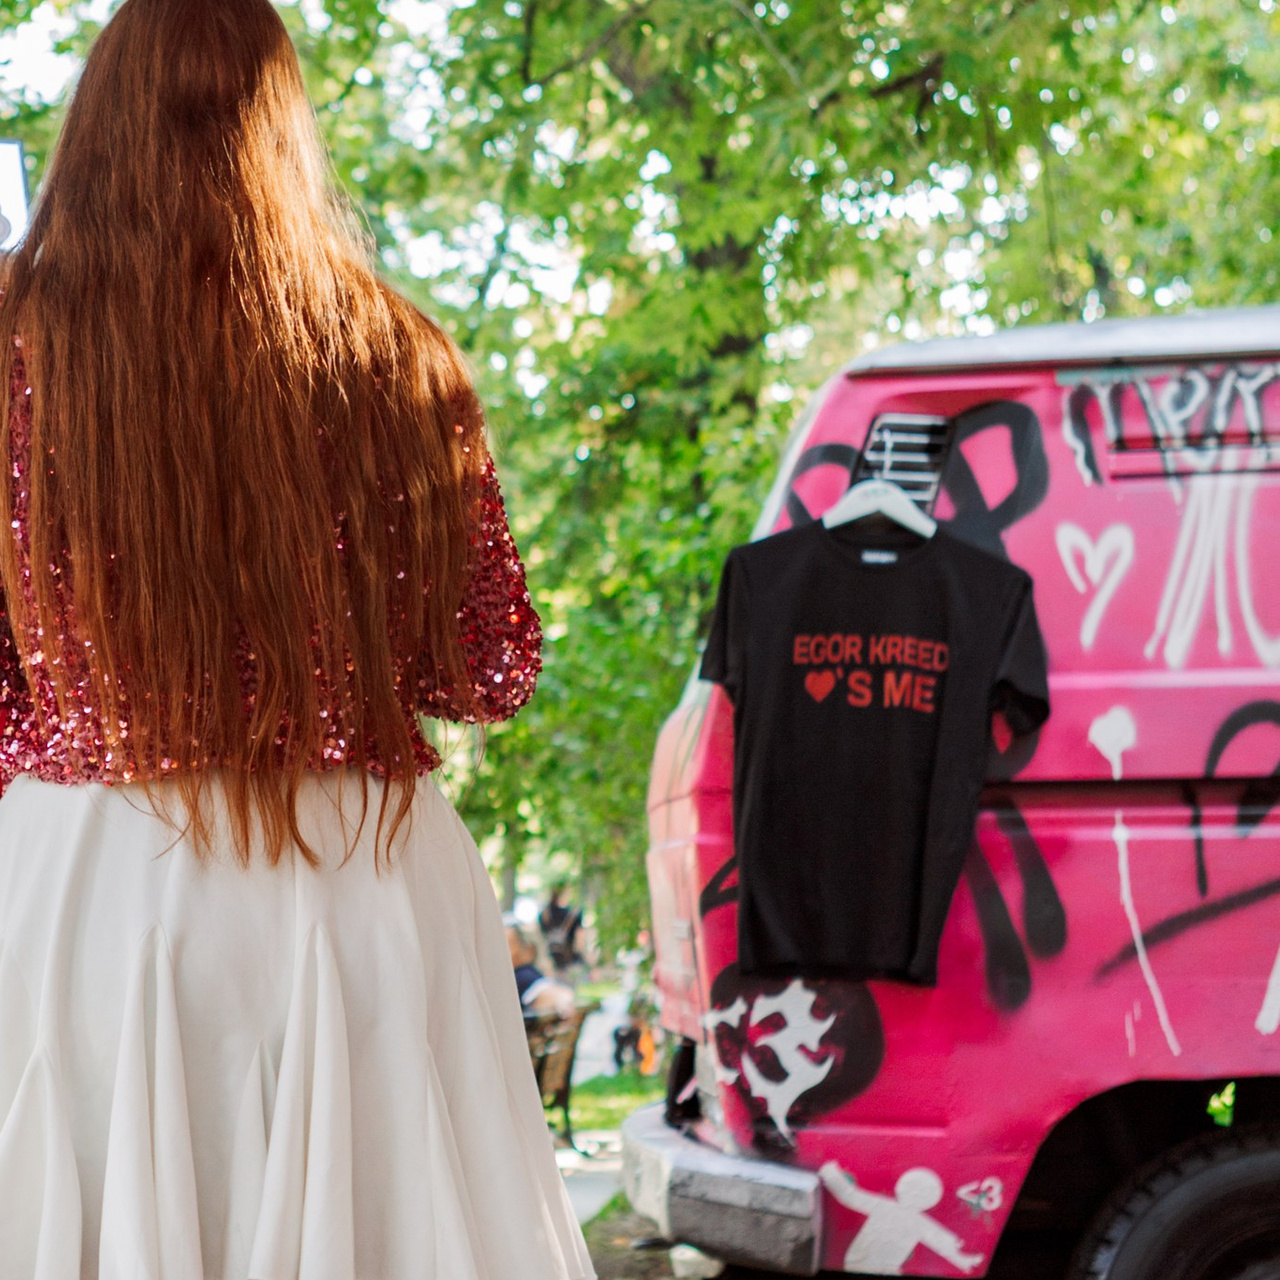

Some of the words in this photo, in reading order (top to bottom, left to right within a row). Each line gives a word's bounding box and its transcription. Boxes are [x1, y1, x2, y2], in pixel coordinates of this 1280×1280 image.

[793, 633, 862, 665] EGOR
[869, 634, 950, 672] KREED
[883, 670, 937, 713] ME
